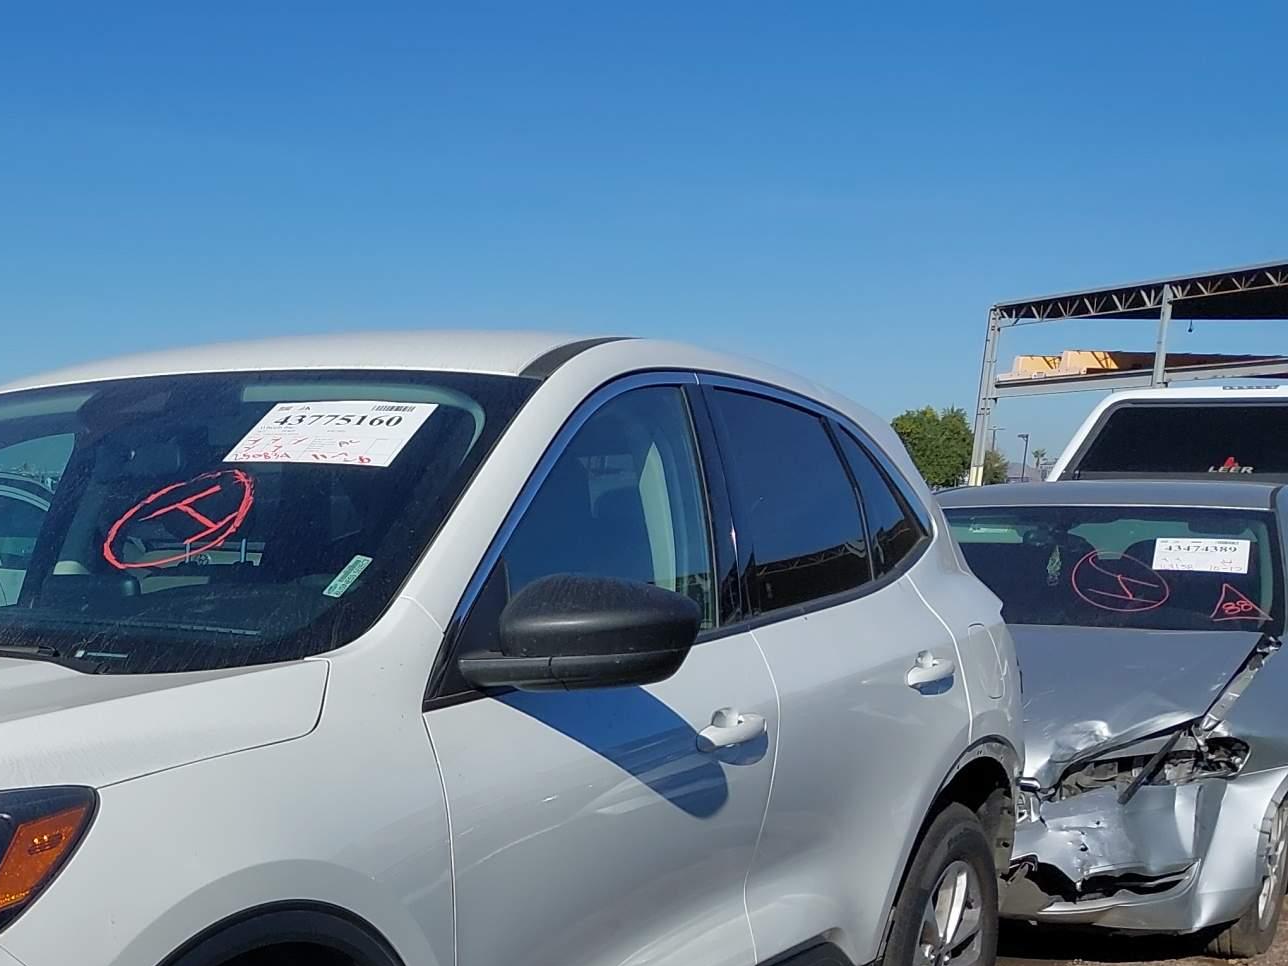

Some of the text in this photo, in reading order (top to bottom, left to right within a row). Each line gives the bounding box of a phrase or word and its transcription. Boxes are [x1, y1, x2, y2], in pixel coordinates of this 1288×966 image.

[274, 413, 404, 428] 43775160
[1208, 466, 1254, 474] LEER
[1164, 545, 1238, 553] 43474389
[1222, 600, 1253, 615] 88
